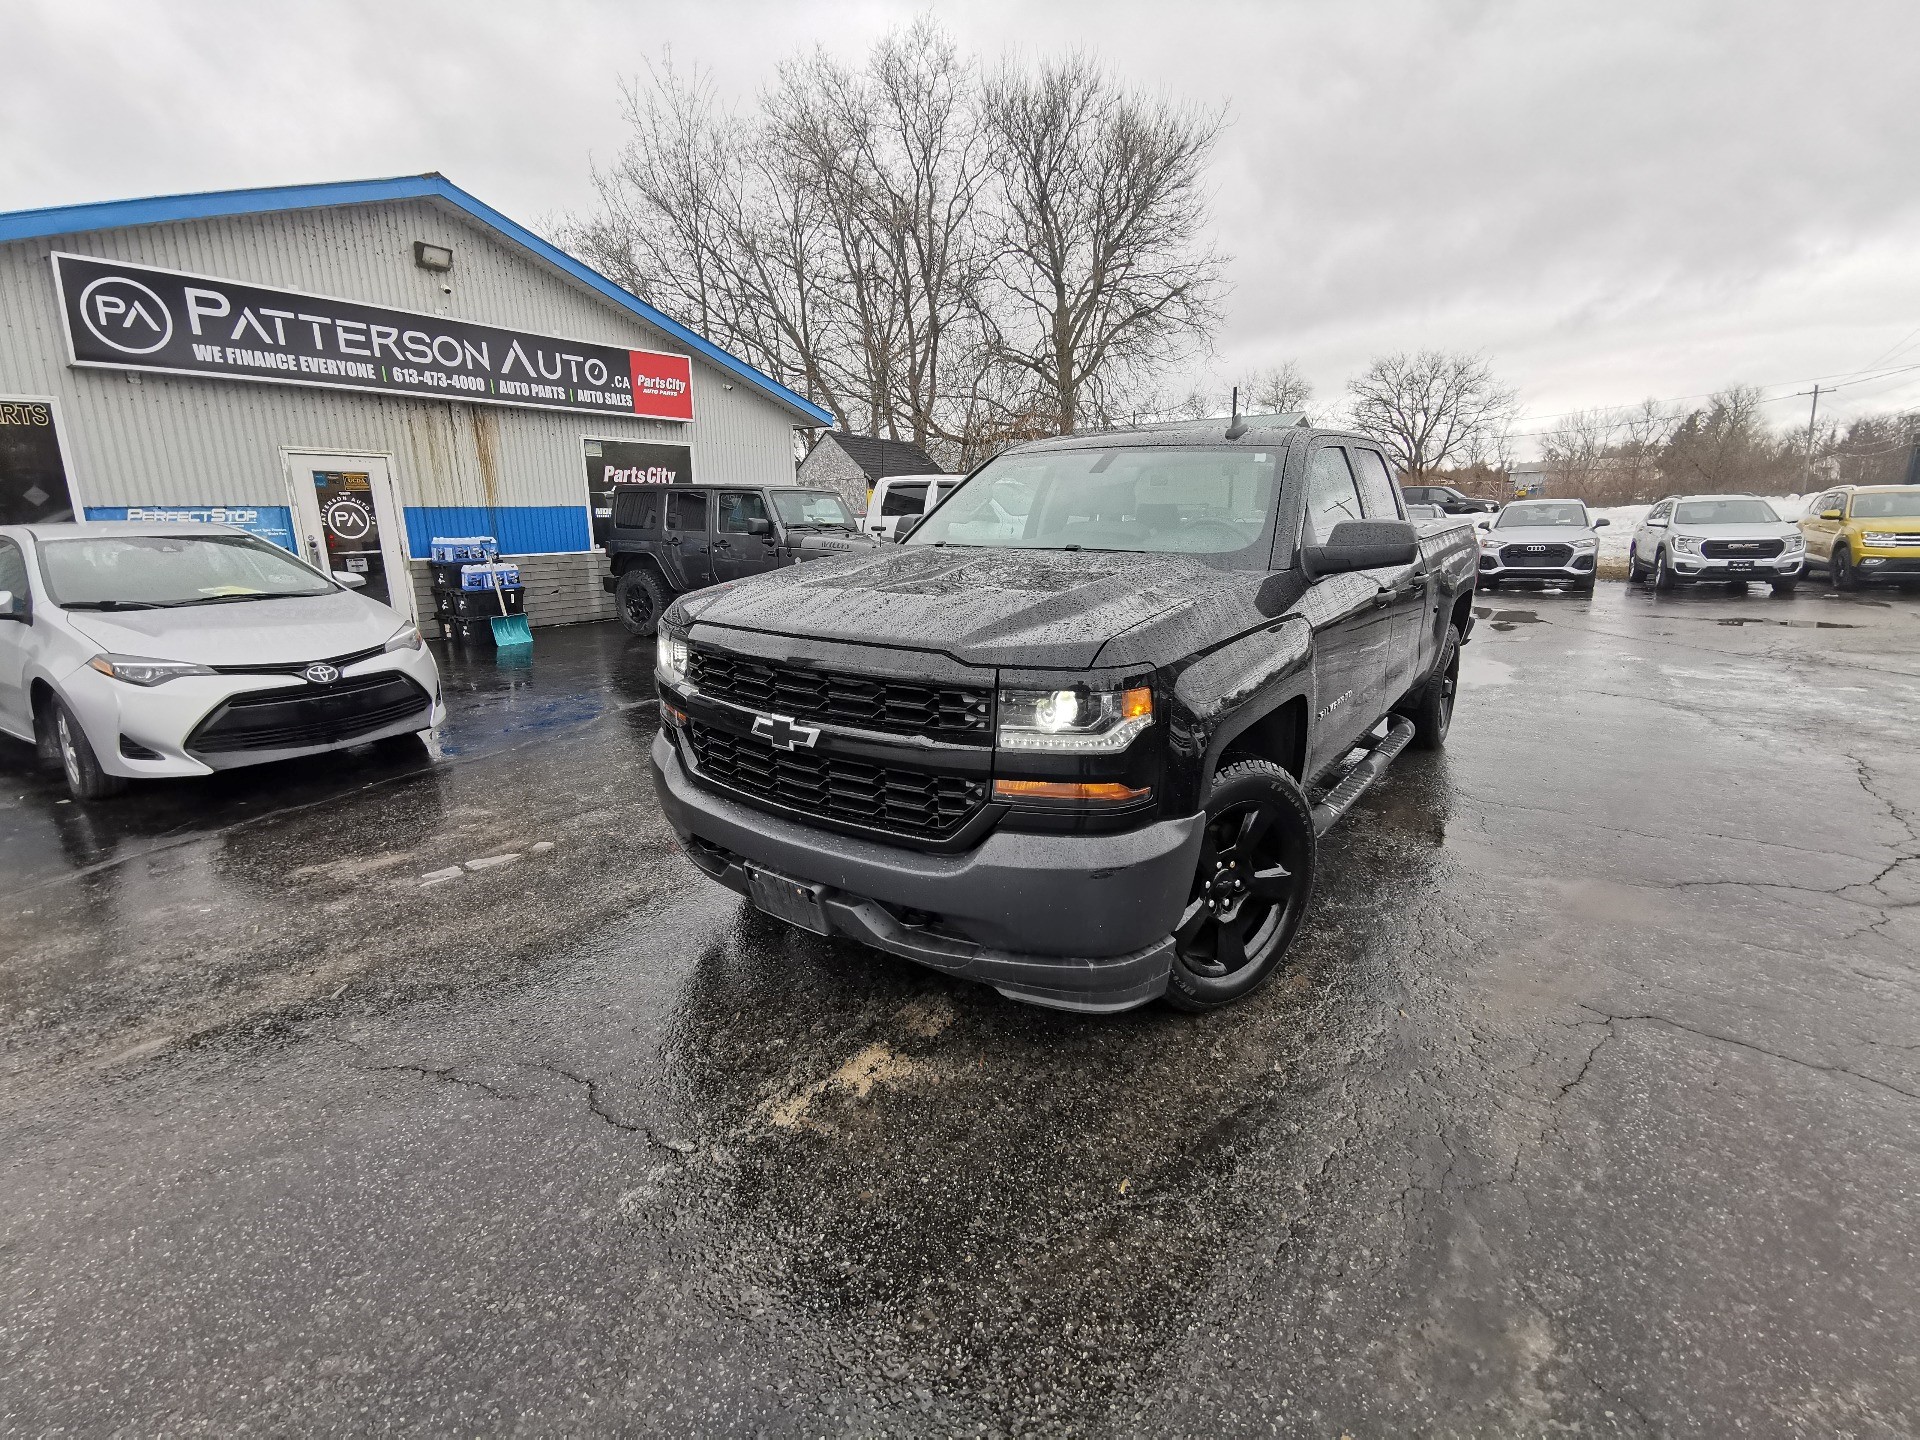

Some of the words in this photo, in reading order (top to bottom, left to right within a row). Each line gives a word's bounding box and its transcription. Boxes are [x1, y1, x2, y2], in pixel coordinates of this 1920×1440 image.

[95, 294, 161, 332] PA
[184, 286, 491, 372] PATTERSON
[501, 338, 608, 386] AUTO
[192, 343, 224, 363] WE
[225, 347, 298, 371] FINANCE
[299, 355, 377, 380] EVERYONE
[392, 366, 486, 392] 613-473-4000
[499, 379, 530, 397] AUTO
[530, 384, 566, 400] PARTS
[637, 374, 686, 394] PartsCity
[577, 388, 604, 404] AUTO
[604, 392, 633, 407] SALES
[350, 497, 371, 511] AUTO
[334, 511, 365, 527] PA
